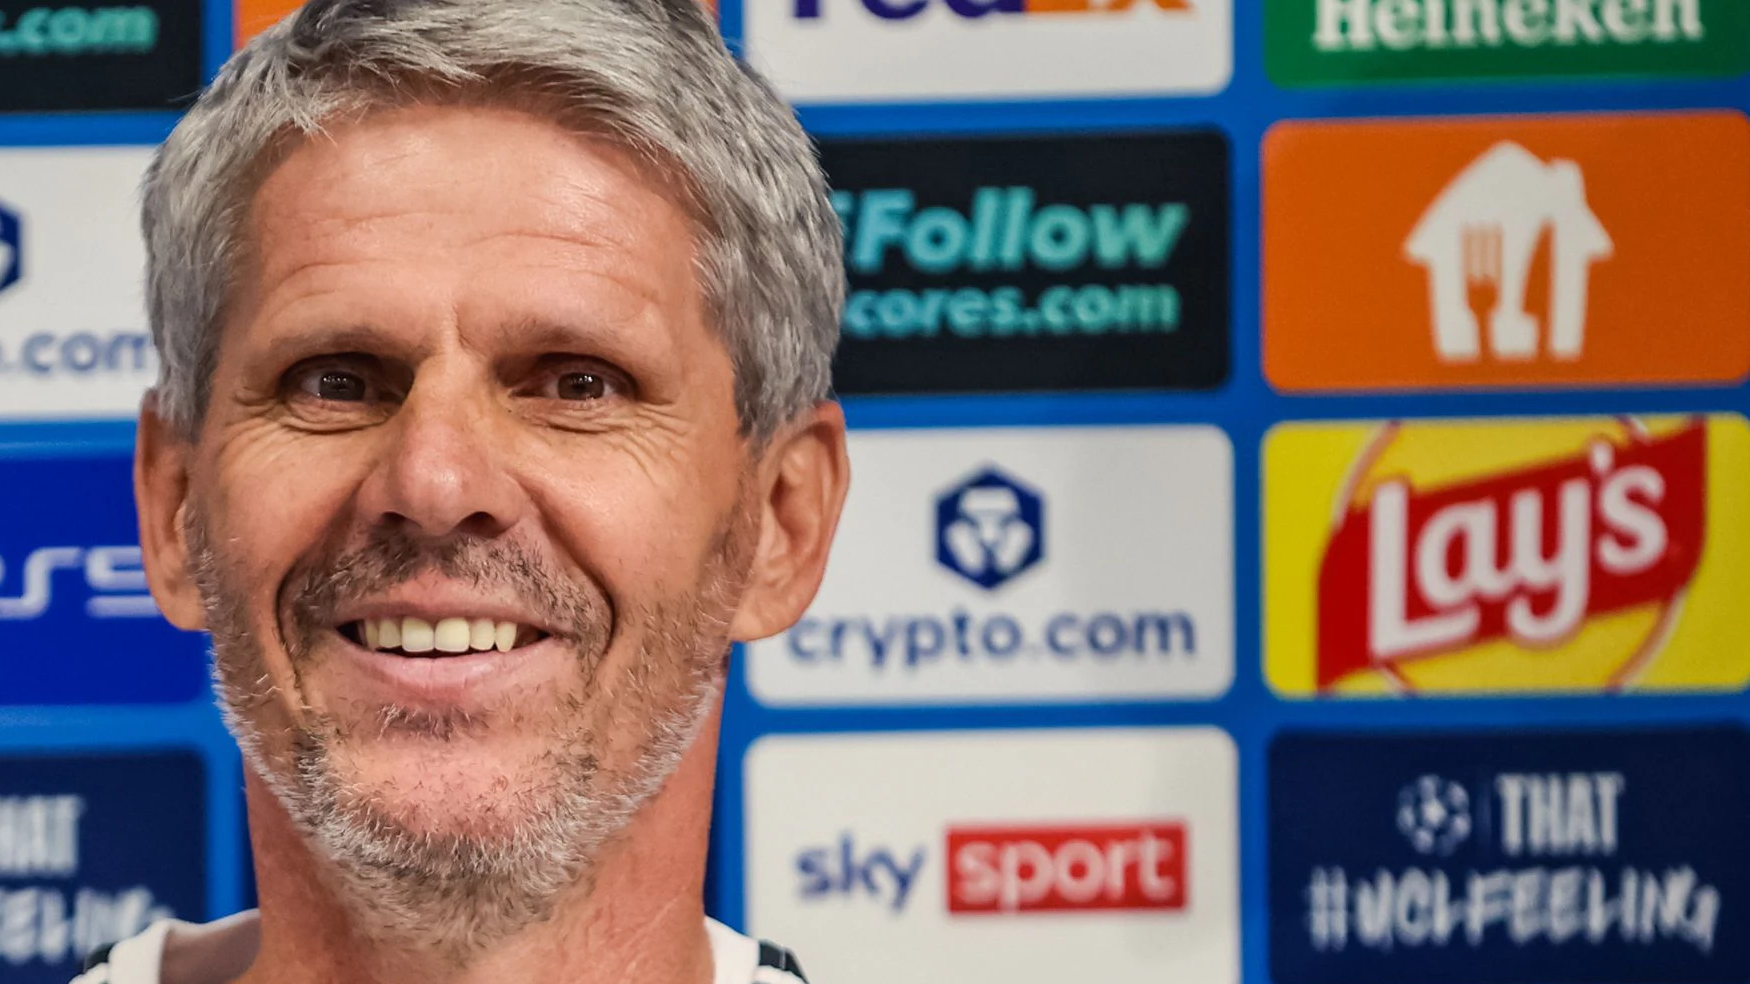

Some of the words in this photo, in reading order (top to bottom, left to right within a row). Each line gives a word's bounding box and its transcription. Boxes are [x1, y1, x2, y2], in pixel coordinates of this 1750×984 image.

[830, 186, 1188, 275] Follow
[842, 283, 1182, 340] cores.com
[1367, 439, 1670, 660] Lay's
[786, 607, 1198, 668] crypto.com
[1496, 772, 1625, 857] THAT
[794, 832, 924, 914] sky
[948, 830, 1175, 914] sport
